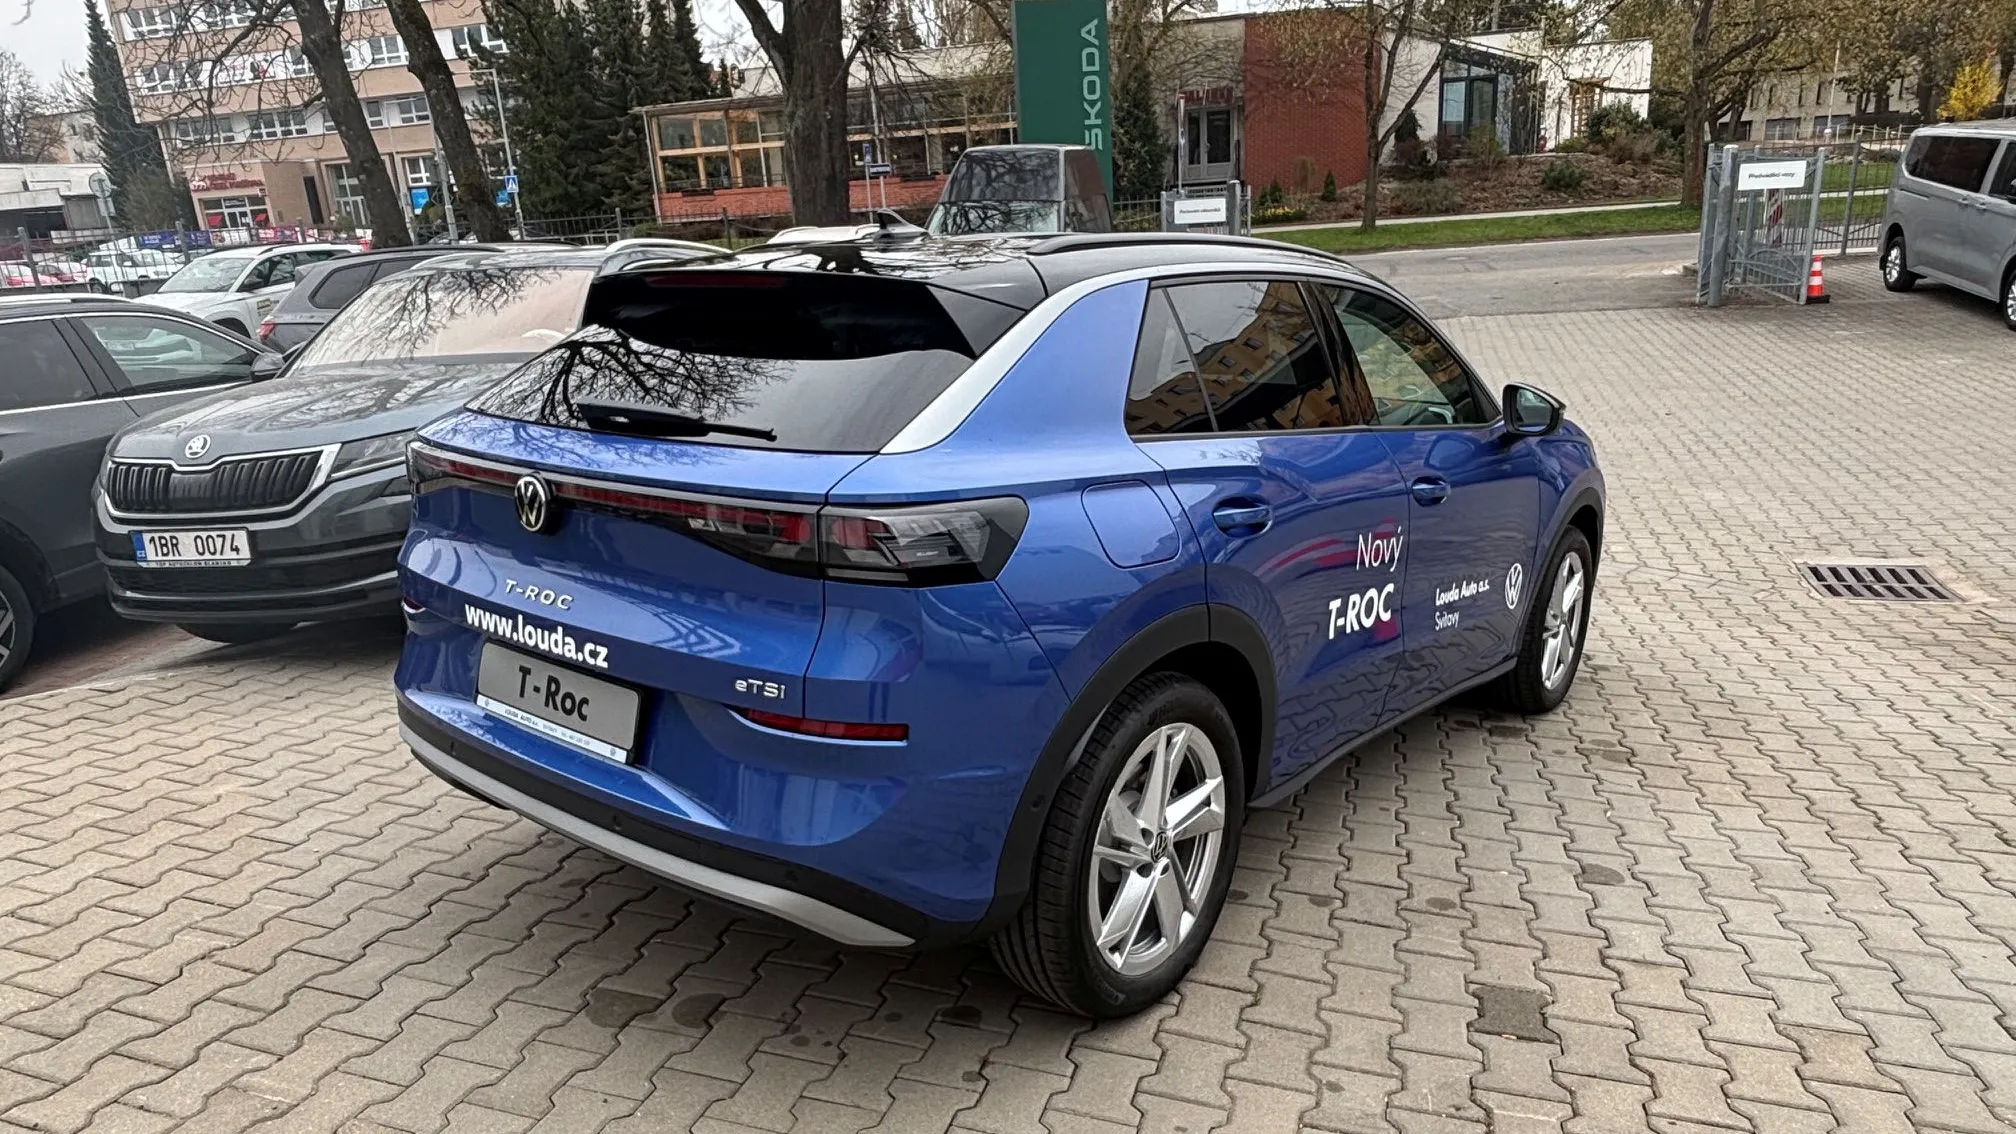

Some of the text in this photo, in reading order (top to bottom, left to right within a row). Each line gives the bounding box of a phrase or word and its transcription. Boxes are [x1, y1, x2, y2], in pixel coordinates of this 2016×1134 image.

[1080, 18, 1103, 150] ŠKODA
[149, 533, 240, 557] 1BR 0074
[1356, 526, 1403, 572] Nový
[505, 579, 575, 610] T-ROC
[1328, 582, 1395, 640] T-ROC
[1435, 582, 1460, 607] Louda
[1460, 580, 1478, 599] Auto
[464, 603, 609, 668] www.louda.cz
[1434, 611, 1460, 631] Svitavy
